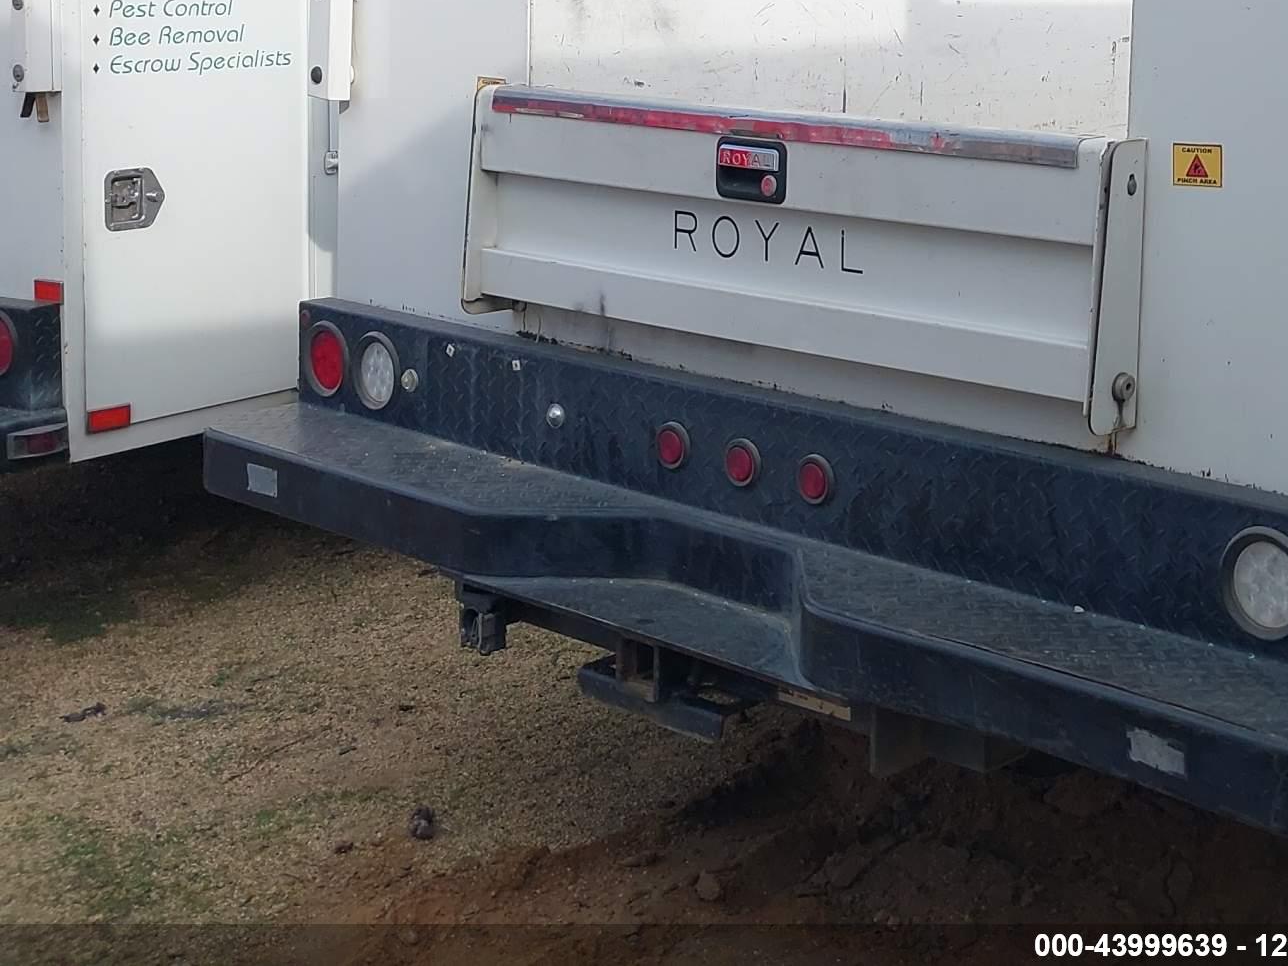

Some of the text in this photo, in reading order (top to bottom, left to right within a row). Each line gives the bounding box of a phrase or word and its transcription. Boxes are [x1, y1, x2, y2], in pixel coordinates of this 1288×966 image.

[109, 0, 156, 18] Pest
[109, 24, 245, 46] Bee Removal
[110, 49, 292, 75] Escrow Specialists
[722, 150, 771, 167] ROYAL
[674, 210, 864, 274] ROYAL
